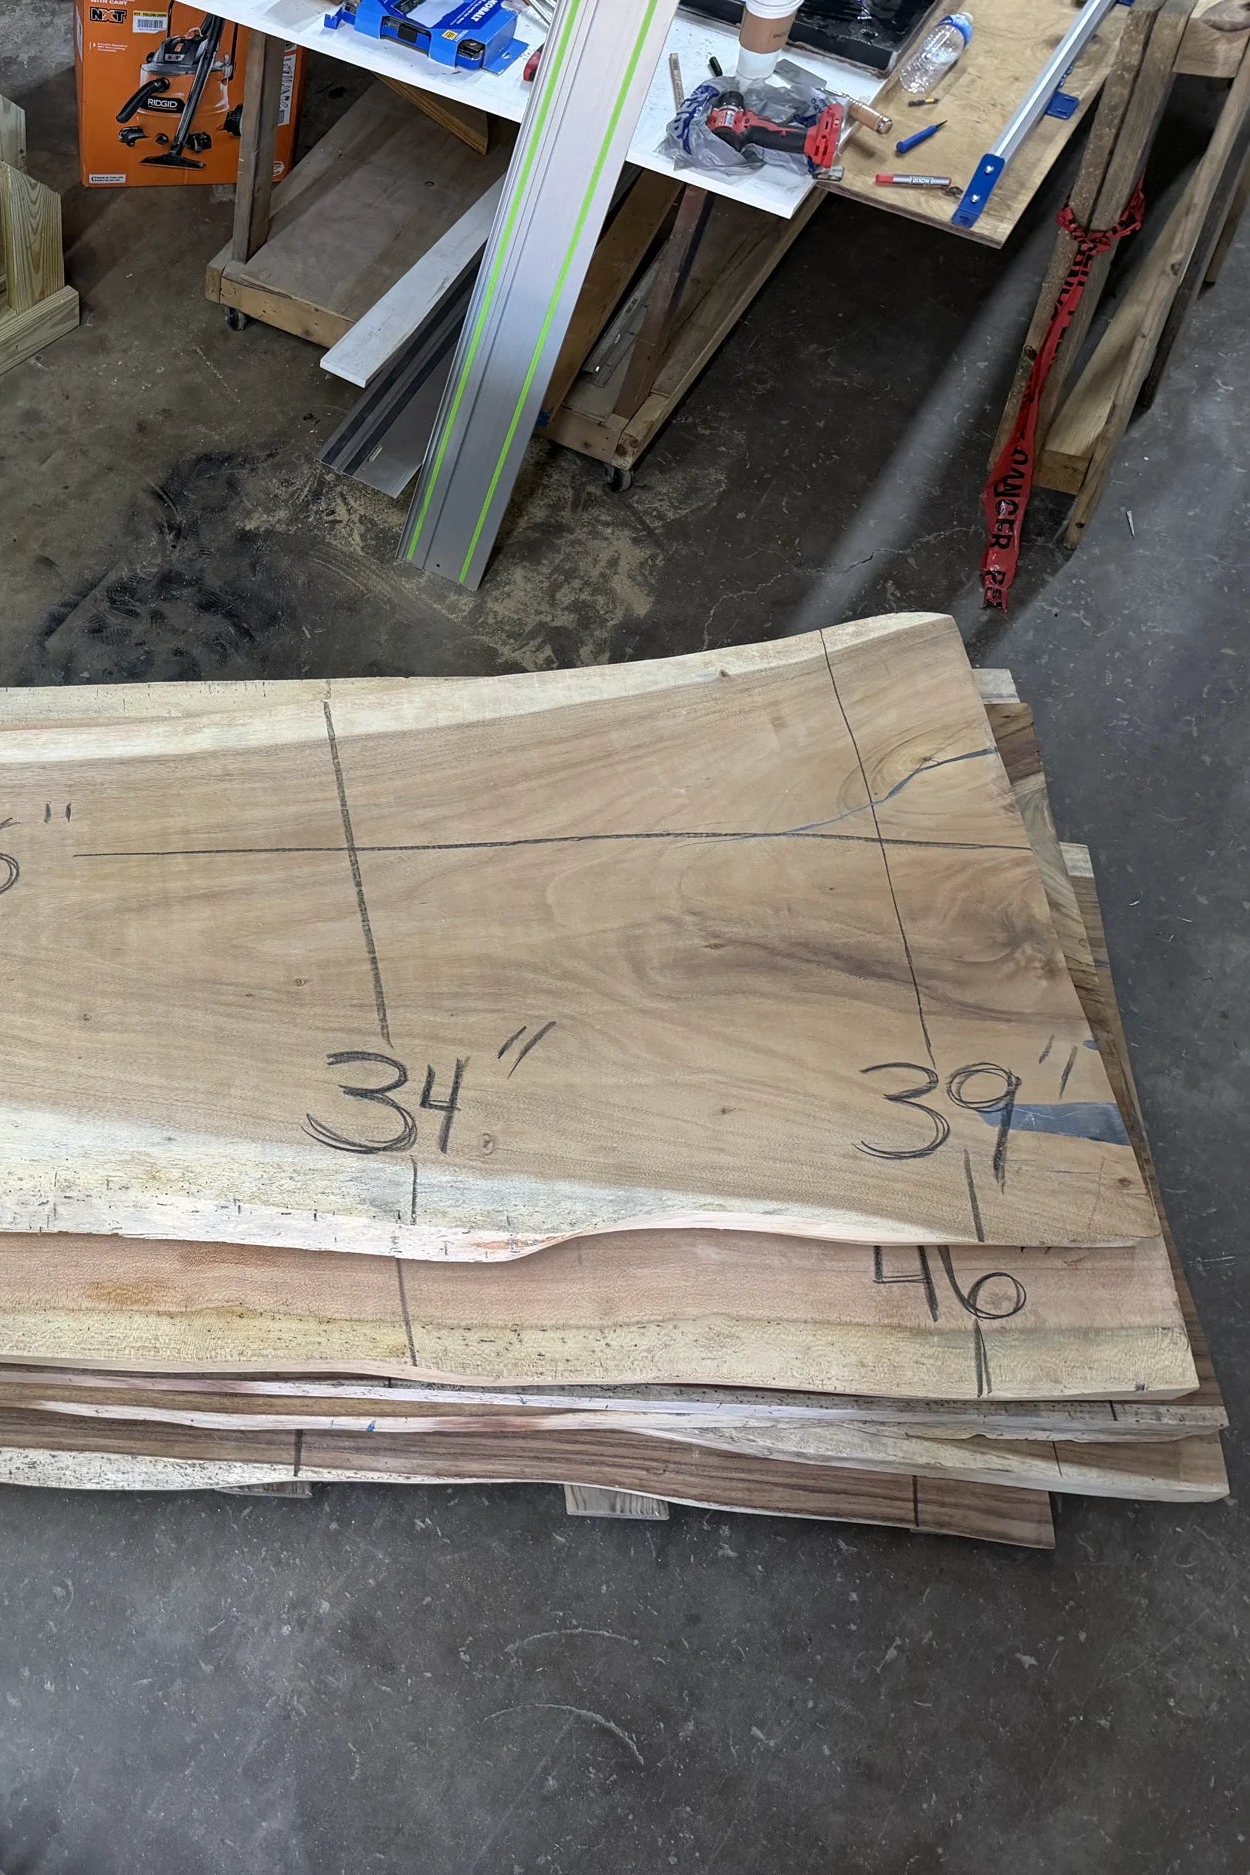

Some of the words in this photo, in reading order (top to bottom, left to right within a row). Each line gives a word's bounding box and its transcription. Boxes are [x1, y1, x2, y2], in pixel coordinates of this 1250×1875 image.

[90, 7, 127, 24] NXT
[147, 98, 178, 108] RIDGID
[301, 1020, 557, 1154] 34"
[851, 1034, 1078, 1195] 39"
